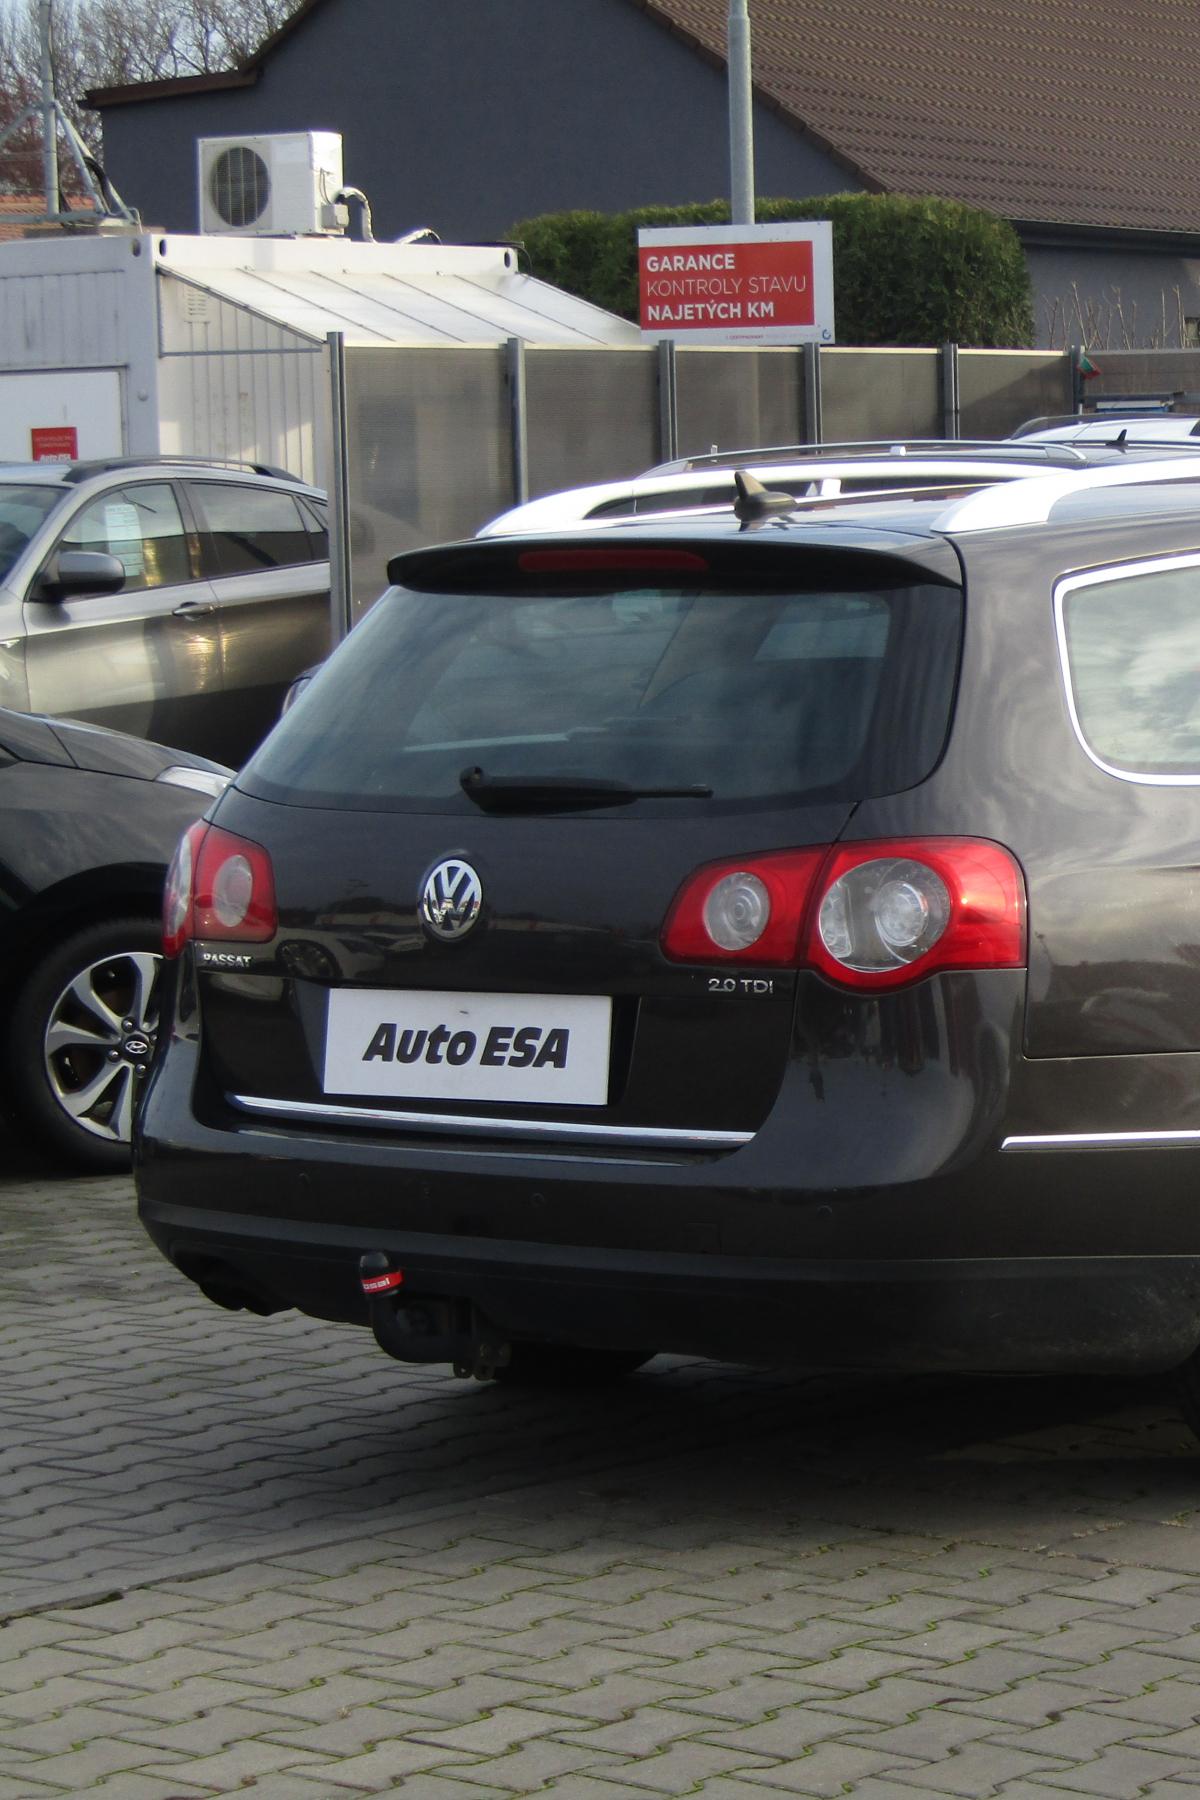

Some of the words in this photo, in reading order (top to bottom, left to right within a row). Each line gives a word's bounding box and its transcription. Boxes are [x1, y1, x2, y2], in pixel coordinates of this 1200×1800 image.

[646, 254, 735, 272] GARANCE
[647, 278, 743, 297] KONTROLY
[748, 275, 806, 294] STAVU
[648, 300, 741, 320] NAJETÝCH
[748, 302, 775, 318] KM
[203, 953, 251, 967] PASSAT
[740, 979, 773, 994] TDI
[361, 1023, 477, 1065] Auto
[479, 1026, 570, 1069] ESA
